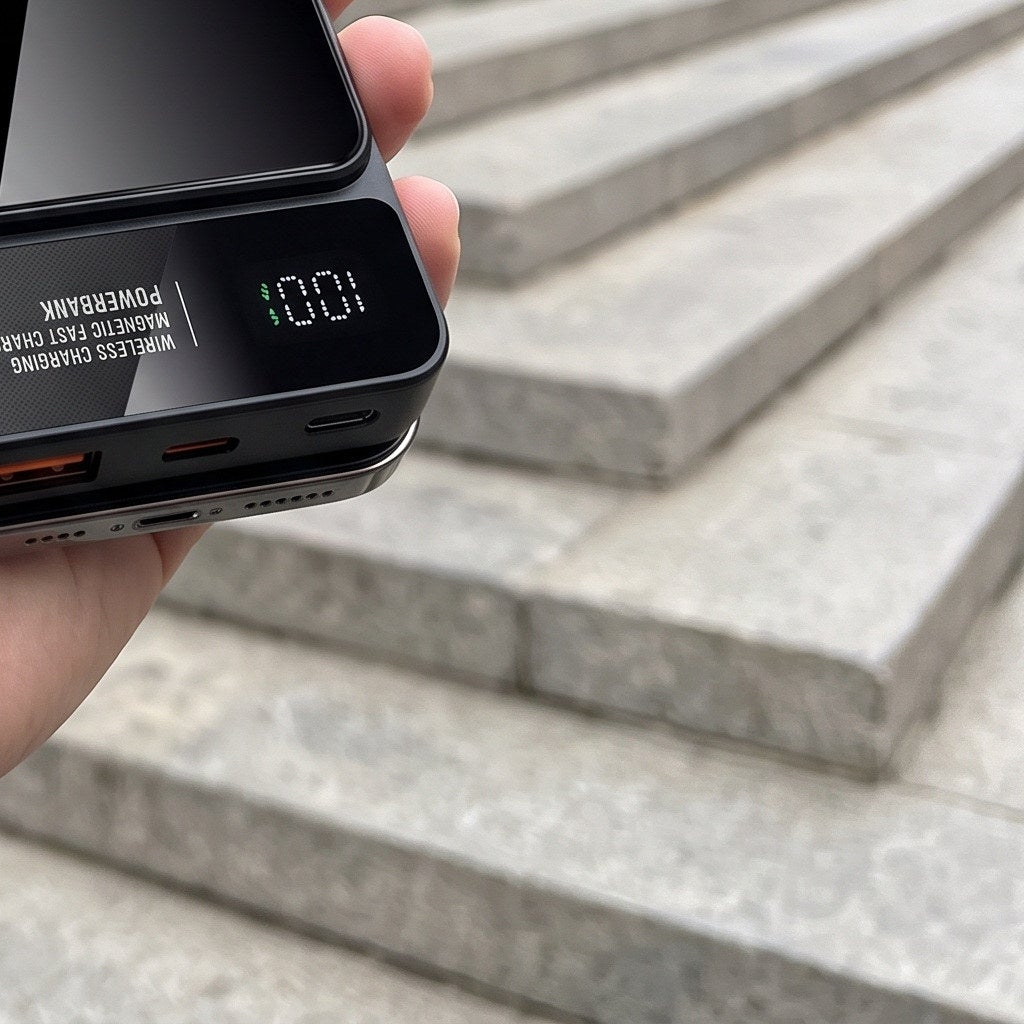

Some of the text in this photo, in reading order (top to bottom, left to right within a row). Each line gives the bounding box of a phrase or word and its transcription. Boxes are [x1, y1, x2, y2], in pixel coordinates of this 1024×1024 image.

[39, 284, 163, 322] POWERBANK
[49, 323, 87, 345] FAST
[91, 311, 171, 338] MAGNETIC
[10, 333, 176, 374] WIRELESS CHARGING
